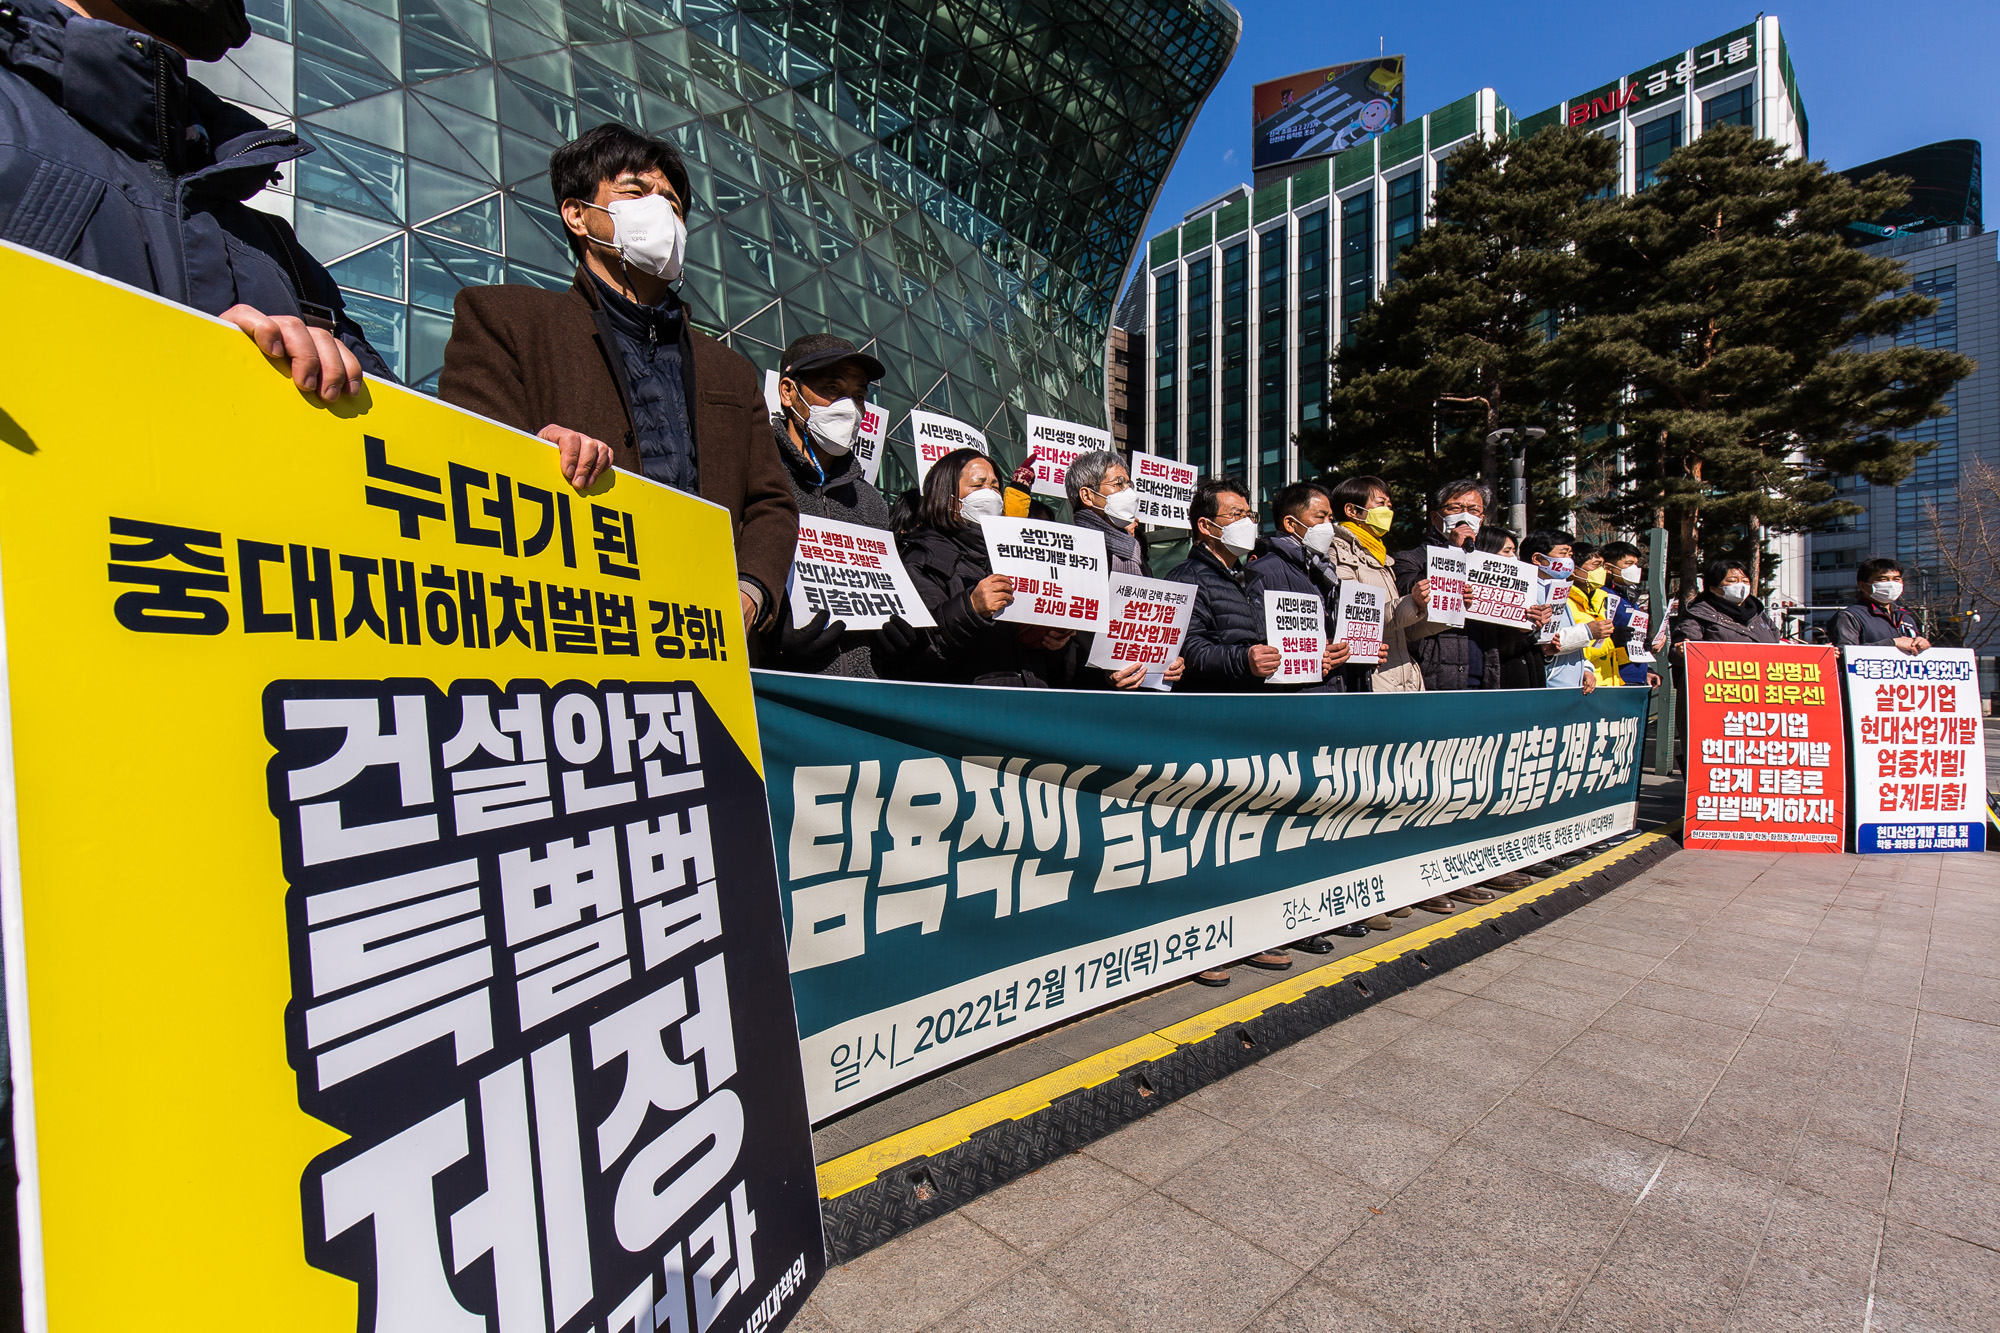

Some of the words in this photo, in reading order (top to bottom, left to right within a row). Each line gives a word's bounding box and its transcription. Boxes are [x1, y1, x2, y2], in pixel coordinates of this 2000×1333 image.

[1570, 82, 1640, 127] BNK
[1645, 37, 1752, 96] 금융그룹
[920, 422, 964, 443] 시민생명
[1033, 426, 1075, 445] 시민생명
[1078, 434, 1105, 450] 앗아간
[1140, 459, 1170, 480] 돈보다
[1170, 465, 1193, 485] 생명!
[1136, 477, 1193, 502] 현대산업개발
[363, 434, 573, 568] 누더기
[591, 503, 641, 582] 된
[821, 530, 855, 550] 생명과
[856, 538, 888, 556] 안전을
[1020, 528, 1074, 551] 살인기업
[799, 544, 847, 565] 탐욕으로
[848, 552, 882, 570] 짓밟은
[997, 543, 1067, 566] 현대산업개발
[1069, 554, 1098, 572] 봐주기
[1431, 556, 1456, 572] 시민생명
[1483, 559, 1518, 577] 살인기업
[1551, 561, 1563, 572] 12
[795, 560, 896, 591] 현대산업개발
[1468, 569, 1529, 593] 현대산업개발
[107, 516, 641, 658] 중대재해처벌법
[649, 599, 728, 662] 강화!
[803, 586, 906, 617] 퇴출하라!
[1042, 580, 1063, 599] 되는
[1116, 585, 1148, 600] 서울시에
[1148, 590, 1163, 602] 강력
[1354, 591, 1376, 606] 살인기업
[1472, 584, 1525, 607] 엄정처벌과
[1034, 597, 1067, 616] 참사의
[1069, 595, 1099, 621] 공범
[1123, 600, 1176, 624] 살인기업
[1276, 597, 1299, 613] 시민의
[1300, 599, 1318, 614] 생명과
[1345, 604, 1380, 623] 현대산업개발
[1107, 619, 1181, 645] 현대산업개발
[1276, 615, 1299, 631] 안전이
[1347, 621, 1379, 640] 엄정처벌과
[1111, 642, 1169, 664] 퇴출하라!
[1282, 637, 1298, 653] 현산
[1299, 638, 1318, 653] 퇴출로
[1705, 661, 1760, 681] 시민의
[1767, 662, 1821, 682] 생명과
[1855, 659, 1908, 679] 학동참사
[1909, 660, 1925, 680] 다
[1926, 660, 1969, 680] 잊었나!
[1704, 683, 1760, 704] 안전이
[1765, 684, 1826, 706] 최우선!
[1875, 684, 1956, 712] 살인기업
[1723, 711, 1809, 738] 살인기업
[1861, 715, 1977, 745] 현대산업개발
[1702, 739, 1831, 767] 현대산업개발
[1877, 749, 1966, 778] 엄중처벌!
[283, 690, 707, 868] 건설안전
[1709, 768, 1753, 794] 업계
[1758, 770, 1823, 795] 퇴출로
[1696, 795, 1834, 823] 일벌백계하자!
[1879, 783, 1967, 812] 업계퇴출!
[1498, 838, 1524, 863] 퇴출을
[1522, 834, 1539, 858] 위한
[1537, 830, 1555, 850] 학동,
[1554, 825, 1573, 846] 화정동
[1573, 820, 1587, 839] 참사
[1586, 812, 1615, 837] 시민대책위
[1692, 831, 1730, 840] 현대산업개발
[1732, 832, 1745, 840] 퇴출
[1746, 832, 1754, 841] 및
[1791, 834, 1804, 843] 참사
[1805, 834, 1837, 843] 시민대책위
[1877, 825, 1936, 839] 현대산업개발
[1937, 825, 1957, 838] 퇴출
[1959, 825, 1968, 838] 및
[1918, 839, 1932, 849] 참사
[1933, 838, 1968, 848] 시민대책위
[789, 756, 1101, 975] 탐욕적인
[1093, 750, 1301, 893] 살인기업
[1276, 734, 1503, 852] 현대산업개발의
[1488, 725, 1556, 816] 퇴출을
[1549, 721, 1591, 804] 강력
[1371, 874, 1386, 903] 앞
[305, 806, 723, 1092] 특별법
[1024, 966, 1066, 1012] 2월
[1075, 938, 1159, 992] 17일(목)
[1162, 926, 1200, 966] 오후
[1205, 915, 1234, 953] 2시
[320, 952, 745, 1333] 제정
